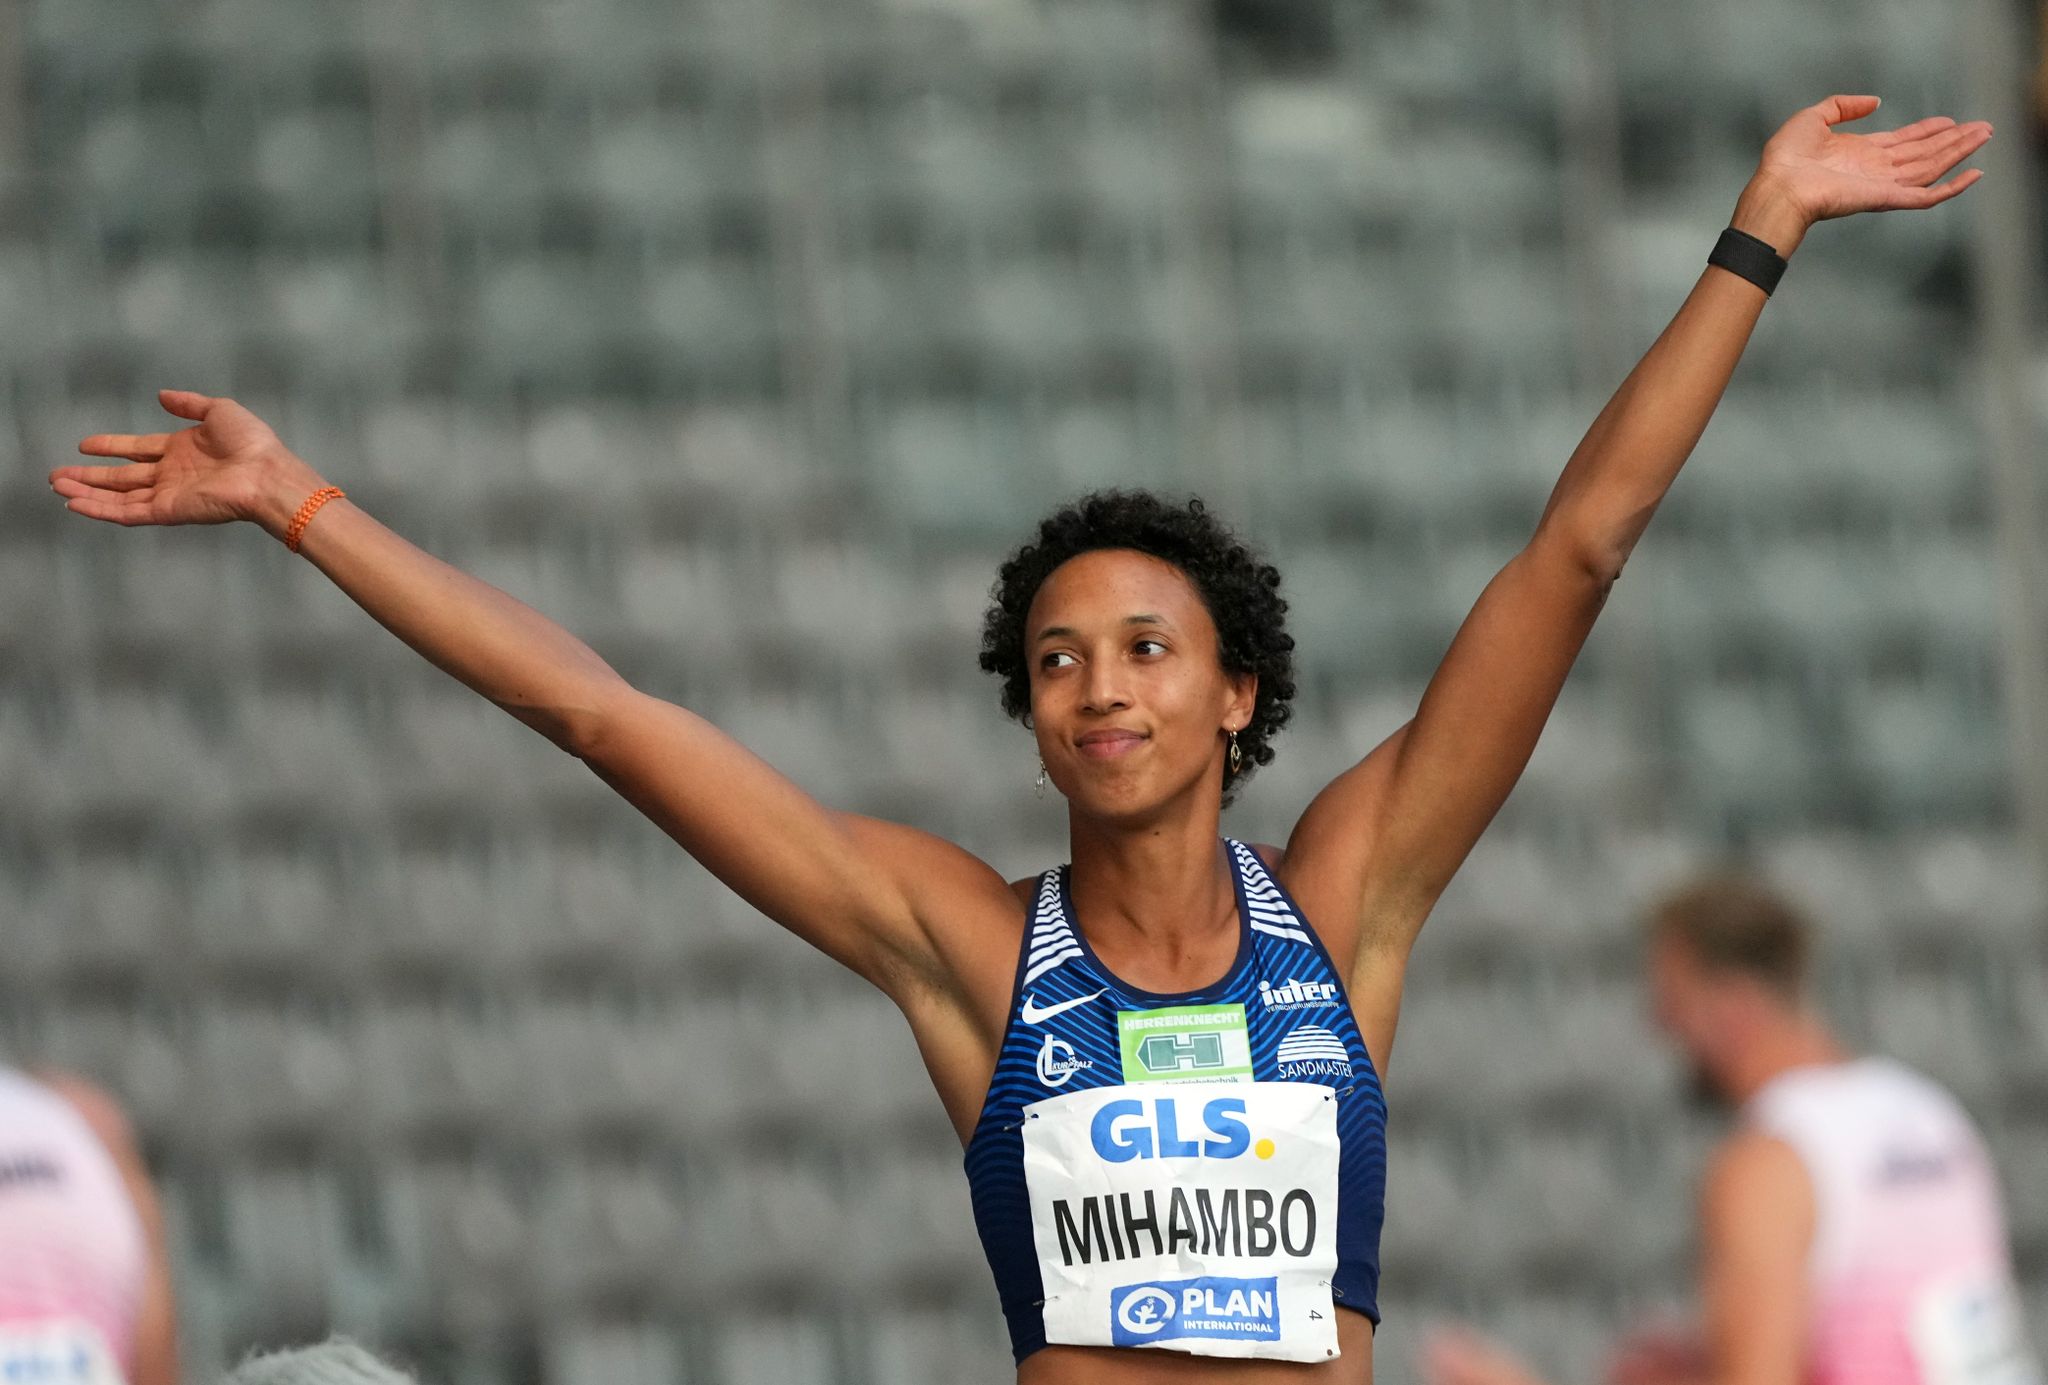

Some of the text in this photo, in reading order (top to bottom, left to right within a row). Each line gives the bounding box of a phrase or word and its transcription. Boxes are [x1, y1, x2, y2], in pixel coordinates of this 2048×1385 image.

[1258, 978, 1336, 1007] inter
[1124, 1012, 1241, 1031] HERRENKNECHT
[1277, 1060, 1355, 1079] SANDMASTER
[1052, 1187, 1317, 1266] MIHAMBO
[1182, 1287, 1273, 1319] PLAN
[1308, 1309, 1324, 1321] 4
[1183, 1319, 1274, 1334] INTERNATIONAL
